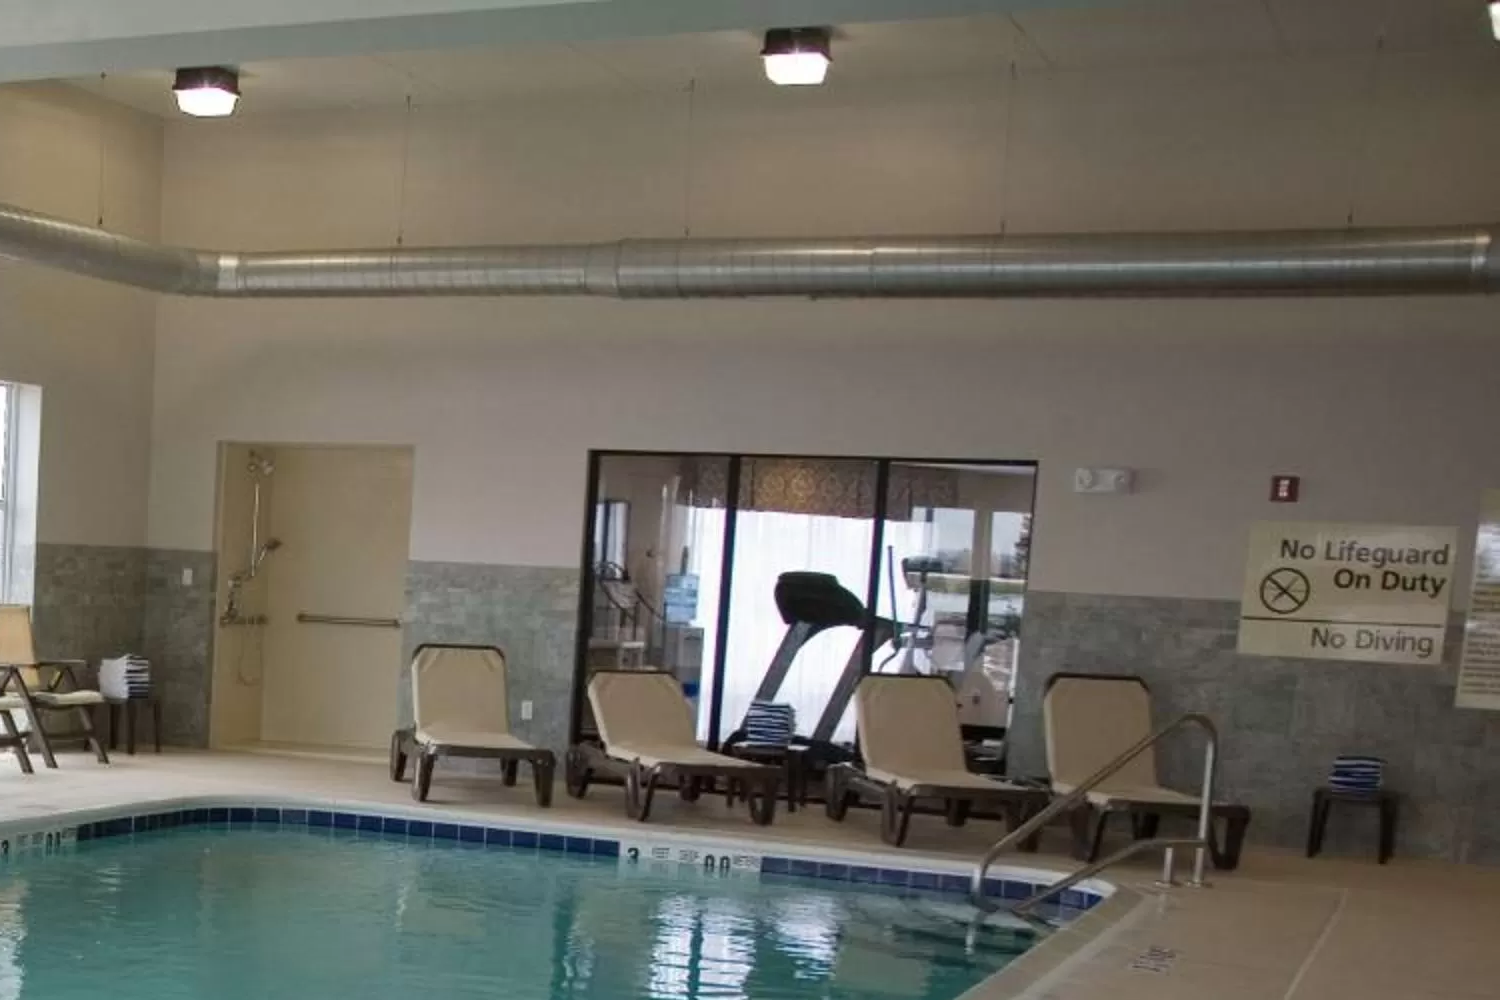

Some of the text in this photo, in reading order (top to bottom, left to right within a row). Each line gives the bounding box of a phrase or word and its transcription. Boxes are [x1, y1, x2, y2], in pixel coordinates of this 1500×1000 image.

[1280, 539, 1316, 560] No
[1325, 540, 1450, 568] Lifeguard
[1333, 568, 1447, 598] On Duty
[1310, 628, 1434, 658] No Diving
